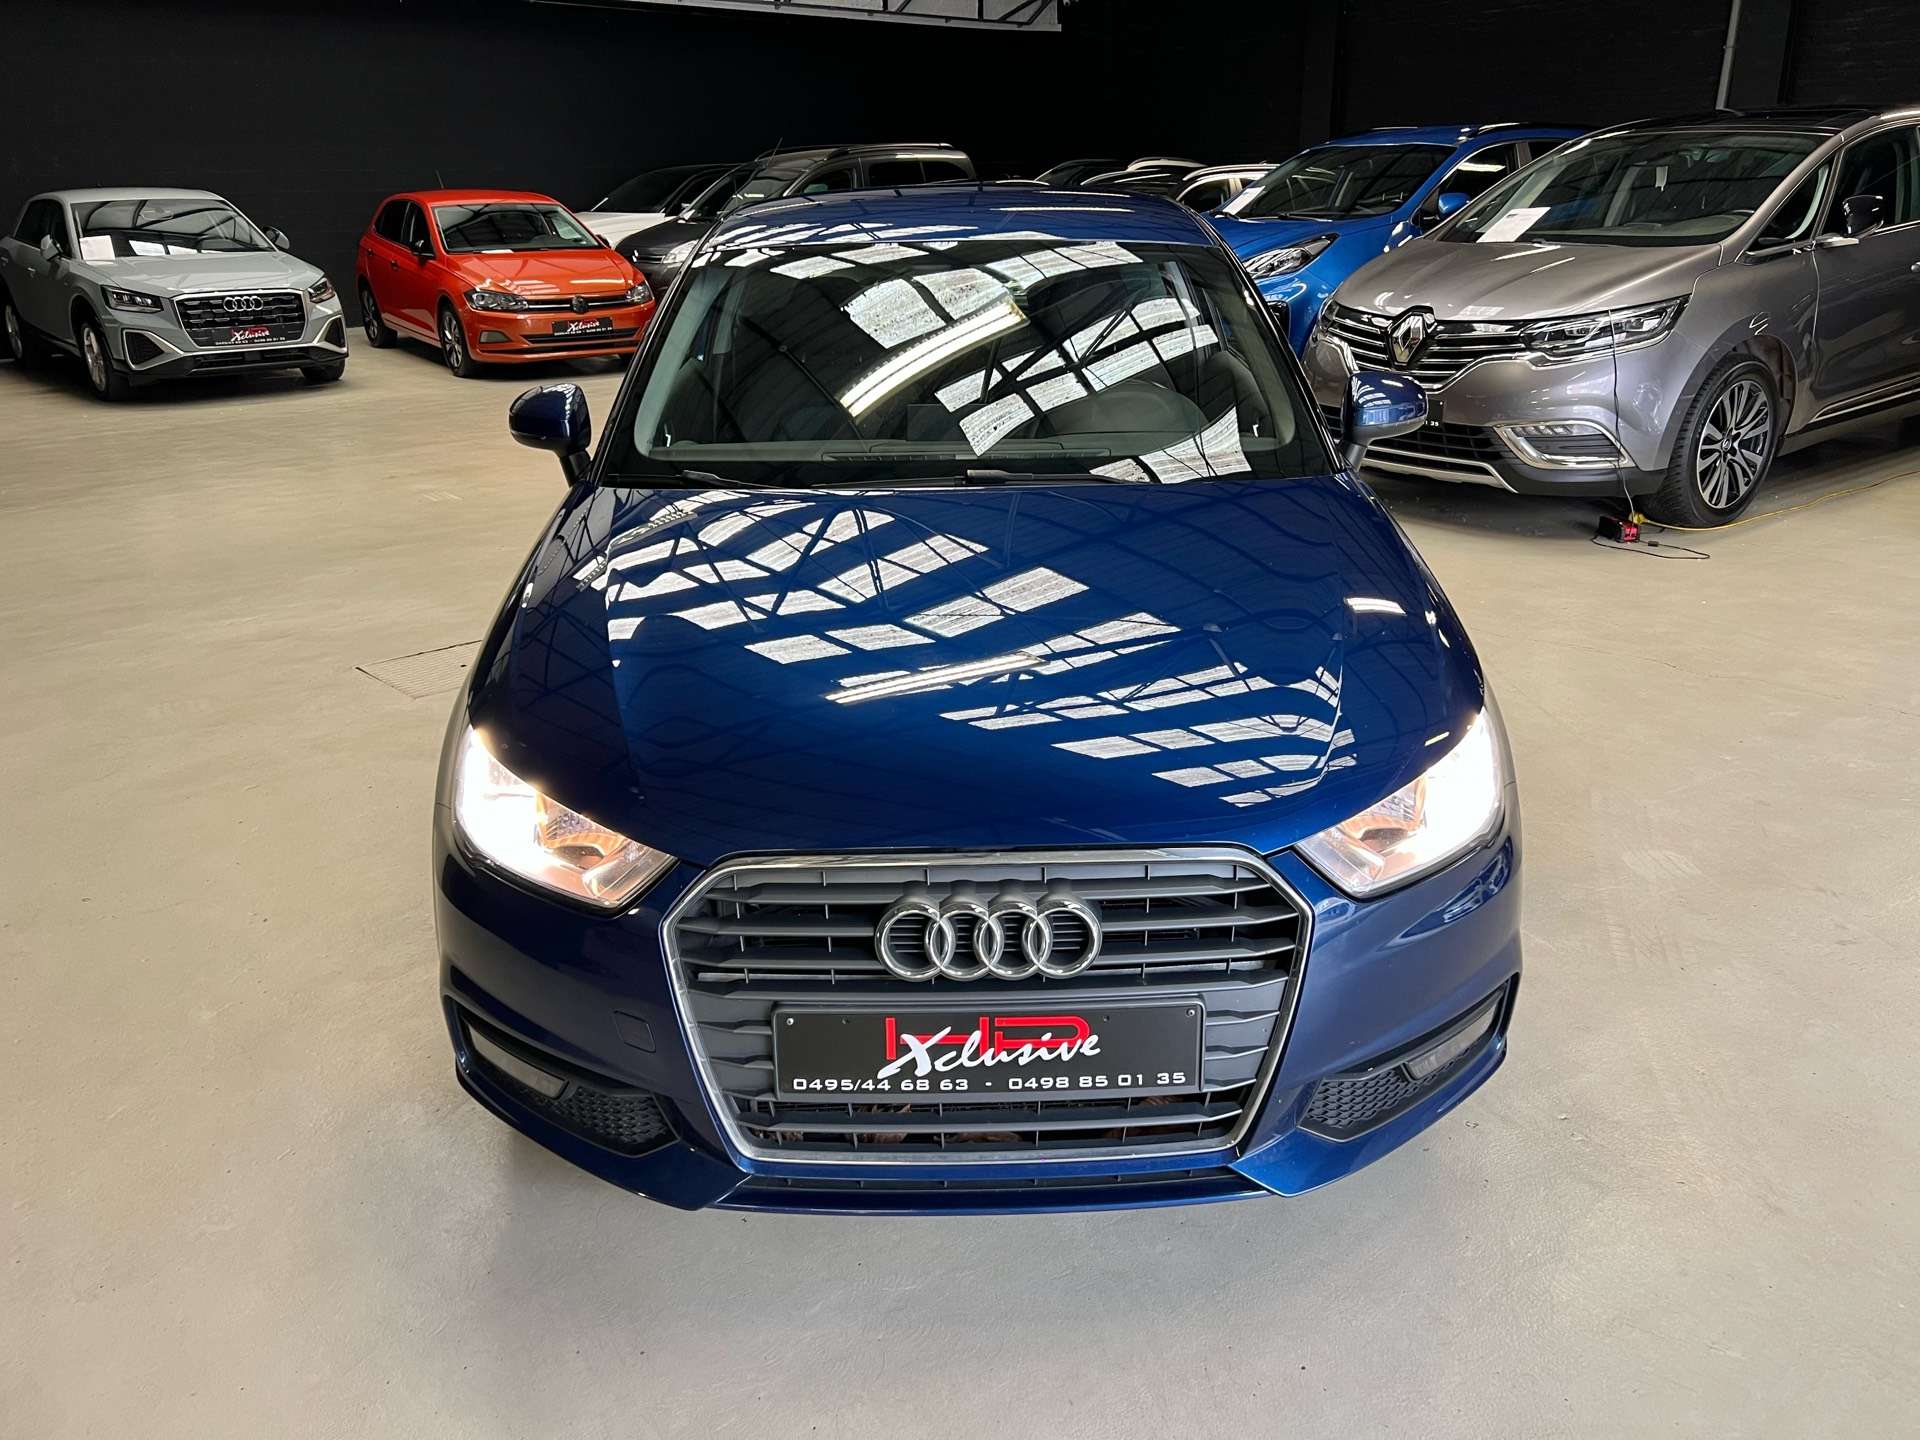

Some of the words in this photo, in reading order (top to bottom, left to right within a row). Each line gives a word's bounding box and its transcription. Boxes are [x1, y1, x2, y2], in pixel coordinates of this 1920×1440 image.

[877, 1026, 1101, 1079] Xclusive
[793, 1078, 891, 1091] 0495/44
[901, 1078, 930, 1091] 68
[940, 1078, 969, 1091] 63
[1008, 1076, 1070, 1090] 0498
[1079, 1075, 1108, 1088] 85
[1117, 1074, 1143, 1086] 01
[1157, 1072, 1186, 1085] 35
